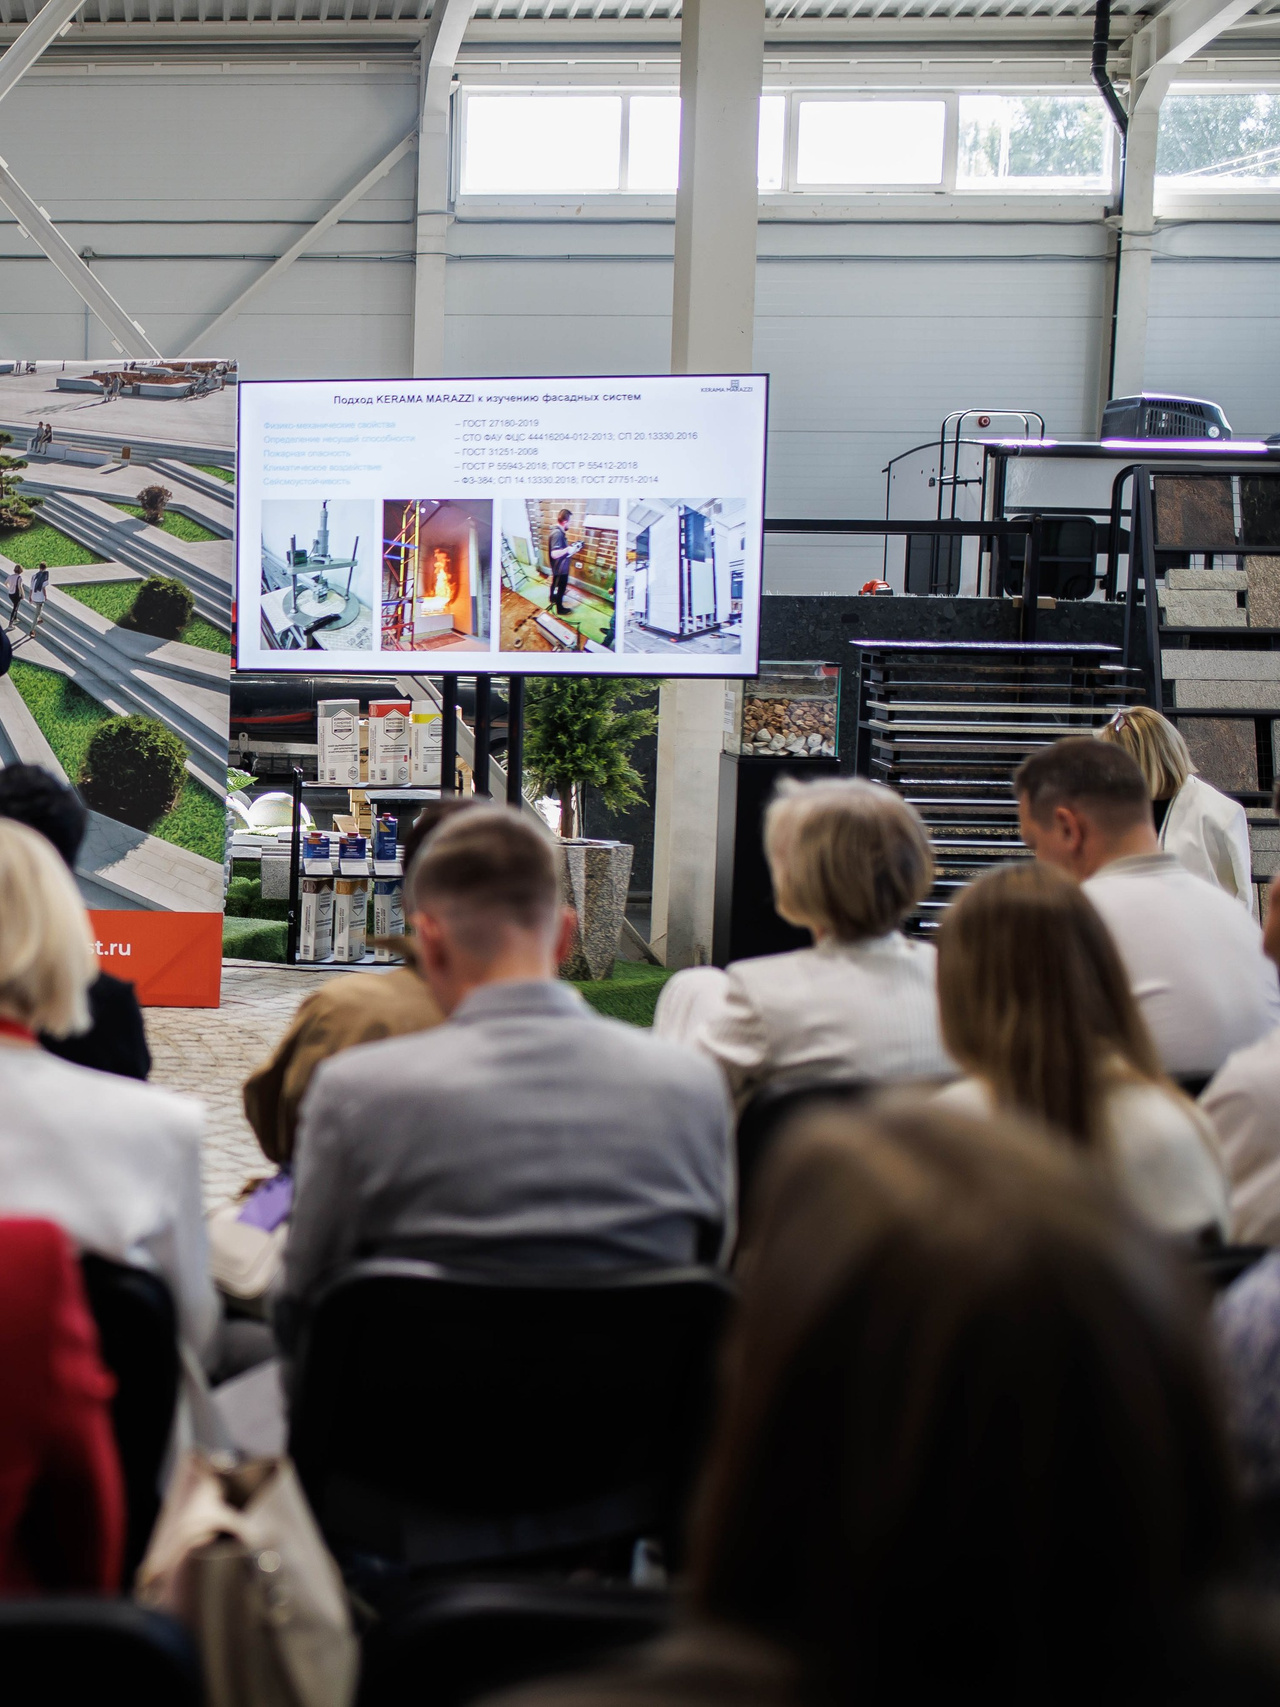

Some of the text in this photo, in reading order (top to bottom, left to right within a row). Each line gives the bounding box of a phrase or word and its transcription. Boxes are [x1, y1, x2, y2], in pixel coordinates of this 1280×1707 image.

[333, 395, 374, 406] Подход
[376, 394, 424, 404] KERAMA
[426, 394, 475, 403] MARAZZI
[486, 394, 539, 405] изучению
[542, 393, 599, 404] фасадных
[602, 393, 641, 402] систем
[358, 420, 396, 429] свойства
[462, 419, 486, 428] ГОСТ
[489, 419, 539, 428] 27180-2019
[263, 434, 416, 445] Определение несущей способности
[462, 433, 482, 442] СТО
[618, 432, 633, 441] СП
[634, 431, 698, 441] 20.13330.2016
[263, 449, 351, 459] Пожарная опасность
[462, 448, 486, 456] ГОСТ
[489, 448, 539, 456] 31251-2008
[263, 463, 327, 472] Климатическое
[462, 462, 486, 471] ГОСТ
[551, 462, 576, 471] ГОСТ
[587, 461, 638, 470] 55412-2018
[497, 476, 512, 485] СП
[581, 476, 606, 485] ГОСТ
[608, 475, 659, 484] 27751-2014
